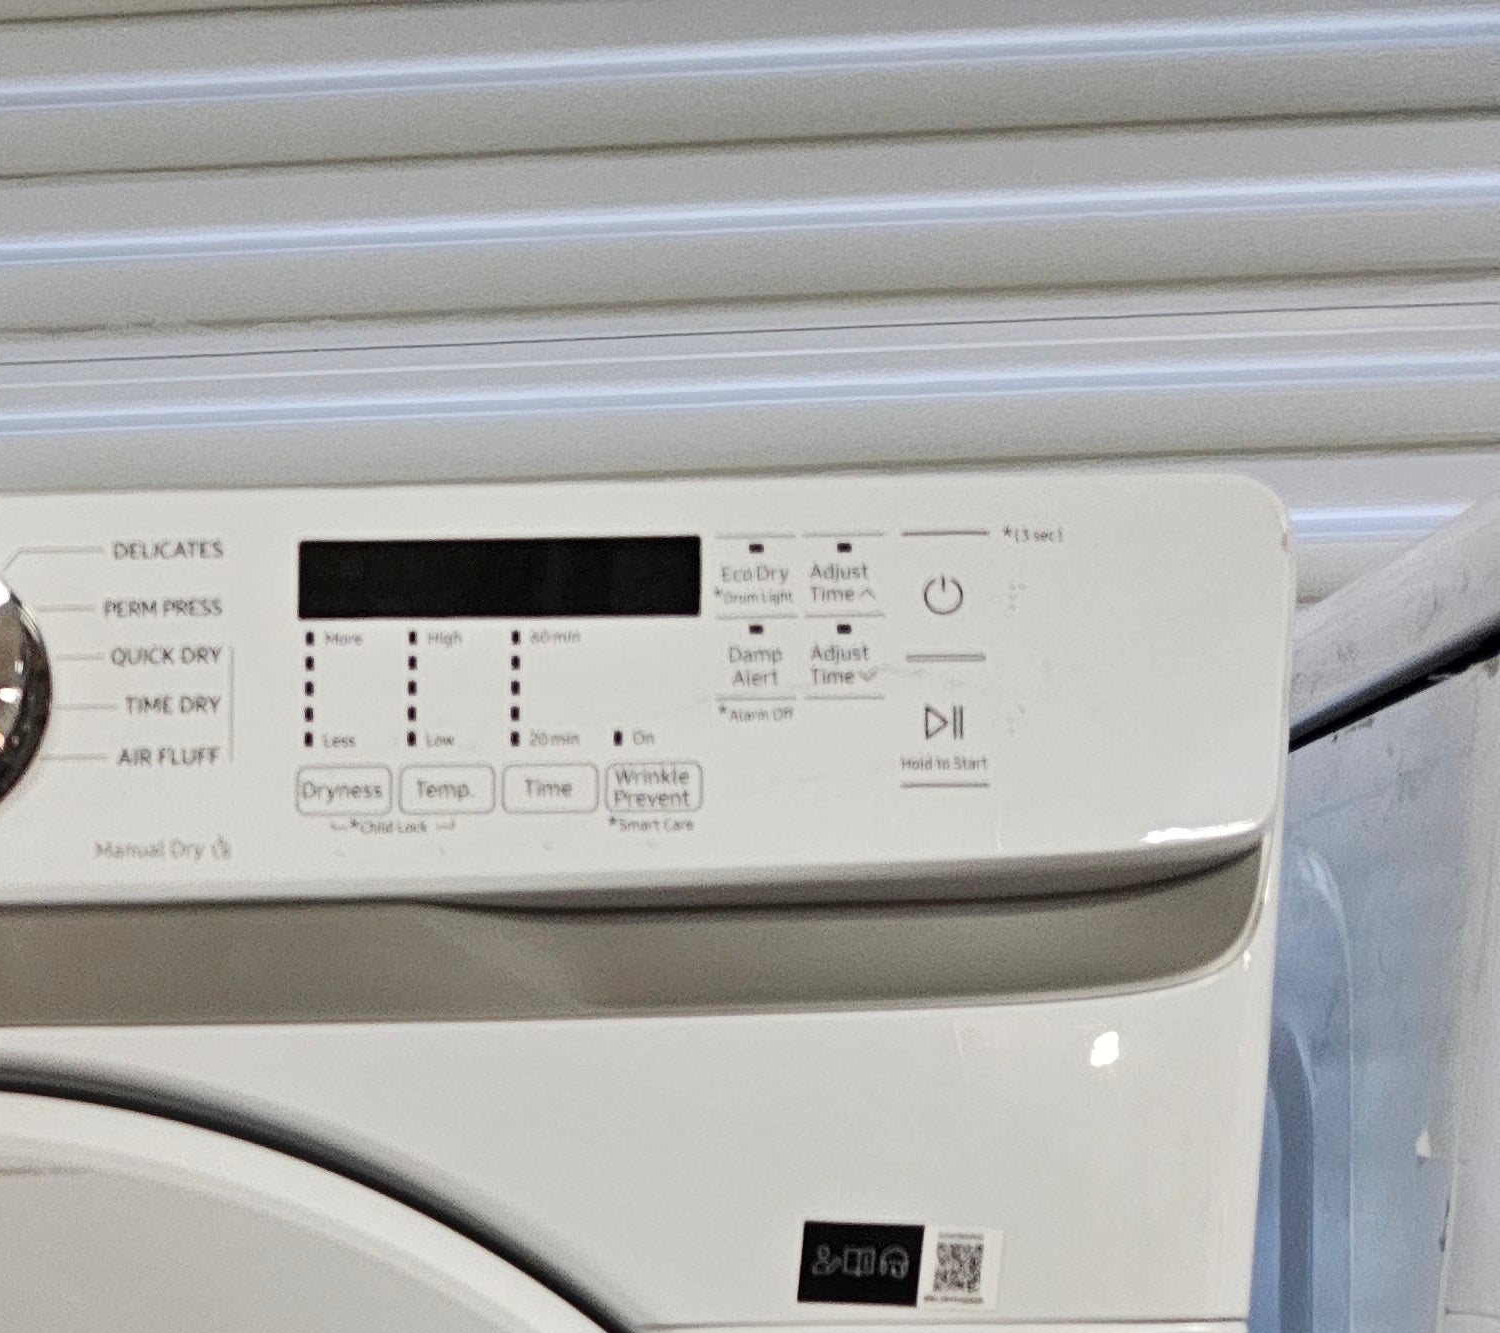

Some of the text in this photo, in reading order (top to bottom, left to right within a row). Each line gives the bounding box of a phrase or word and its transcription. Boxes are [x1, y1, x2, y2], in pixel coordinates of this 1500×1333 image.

[113, 541, 224, 560] DELICATES
[810, 563, 868, 584] Adjust
[811, 586, 855, 602] Time
[104, 598, 223, 618] PERM PRESS
[324, 631, 363, 646] More
[427, 630, 463, 648] High
[111, 647, 222, 668] QUICK DRY
[729, 645, 783, 665] Damp
[811, 644, 869, 664] Adjust
[732, 668, 778, 687] Alert
[811, 668, 855, 685] Time
[124, 695, 221, 715] TIME DRY
[323, 732, 356, 748] Less
[426, 732, 455, 747] Low
[632, 730, 655, 746] On
[116, 747, 220, 767] AIR FLUFF
[901, 756, 932, 772] Hold
[953, 755, 987, 771] Start
[614, 768, 690, 787] Wrinkle
[302, 781, 383, 802] Dryness
[525, 777, 573, 798] Time
[614, 789, 690, 808] Prevent
[663, 817, 694, 832] Care
[94, 838, 205, 862] Manual Dry
